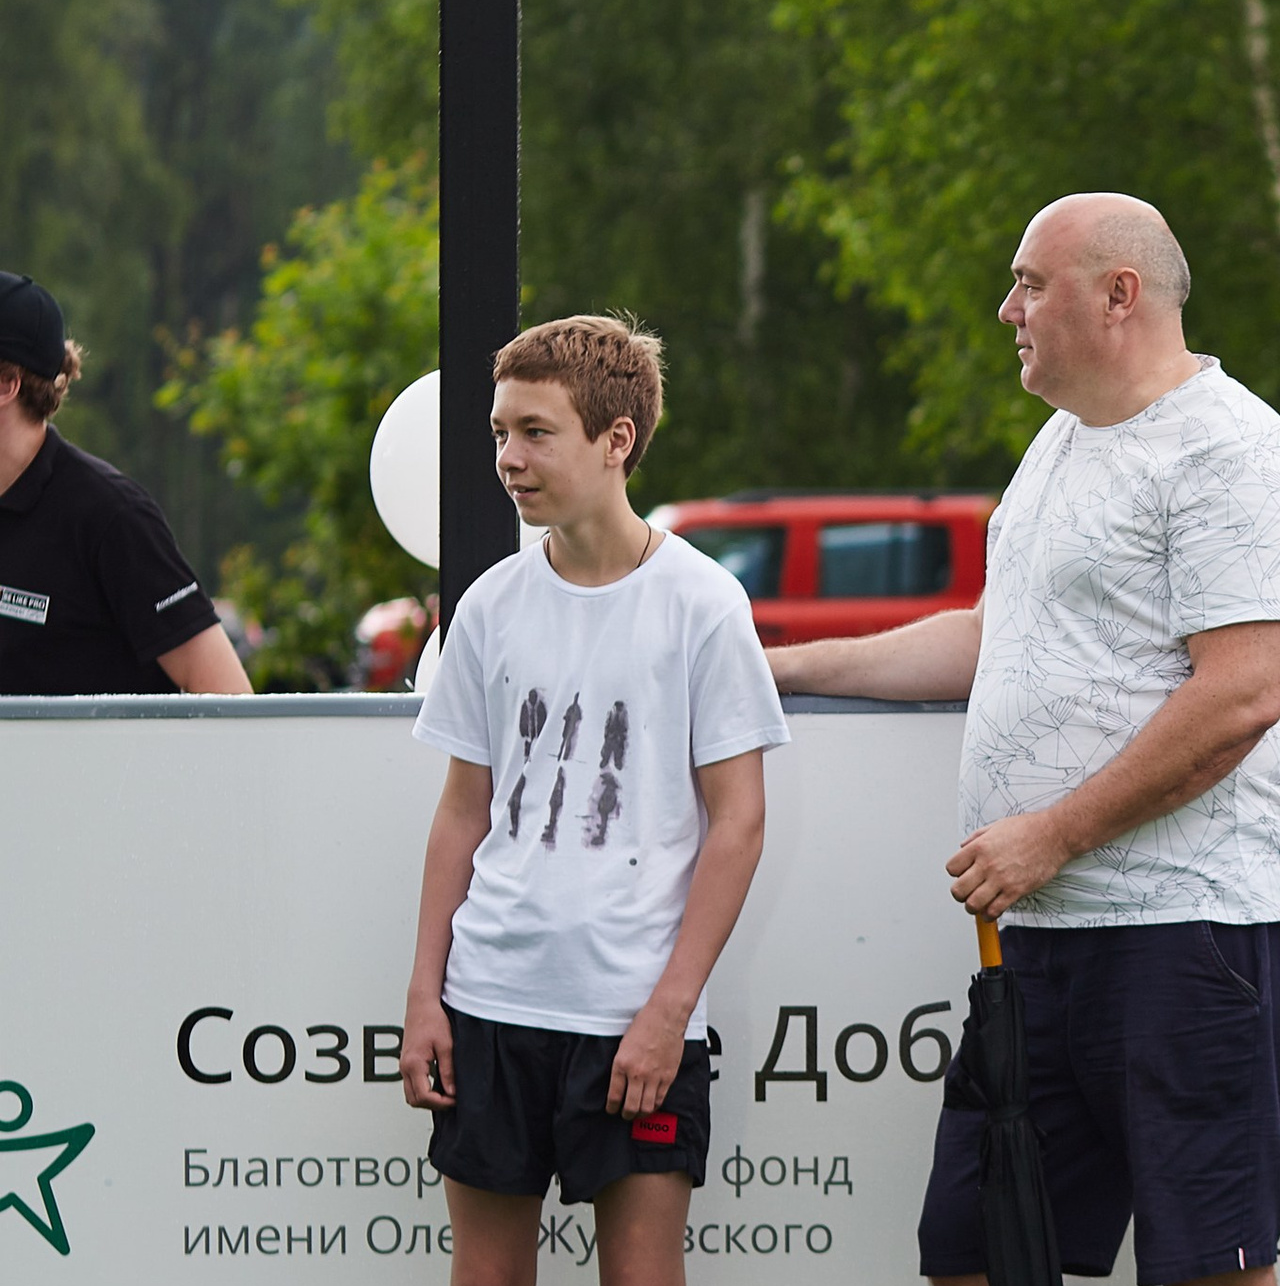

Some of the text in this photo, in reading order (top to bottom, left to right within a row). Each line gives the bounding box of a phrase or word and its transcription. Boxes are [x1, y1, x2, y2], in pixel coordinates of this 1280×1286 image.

[755, 1001, 952, 1102] Доб
[184, 1144, 853, 1199] Благотвор фонд
[184, 1225, 347, 1255] имени
[366, 1215, 452, 1255] Оле
